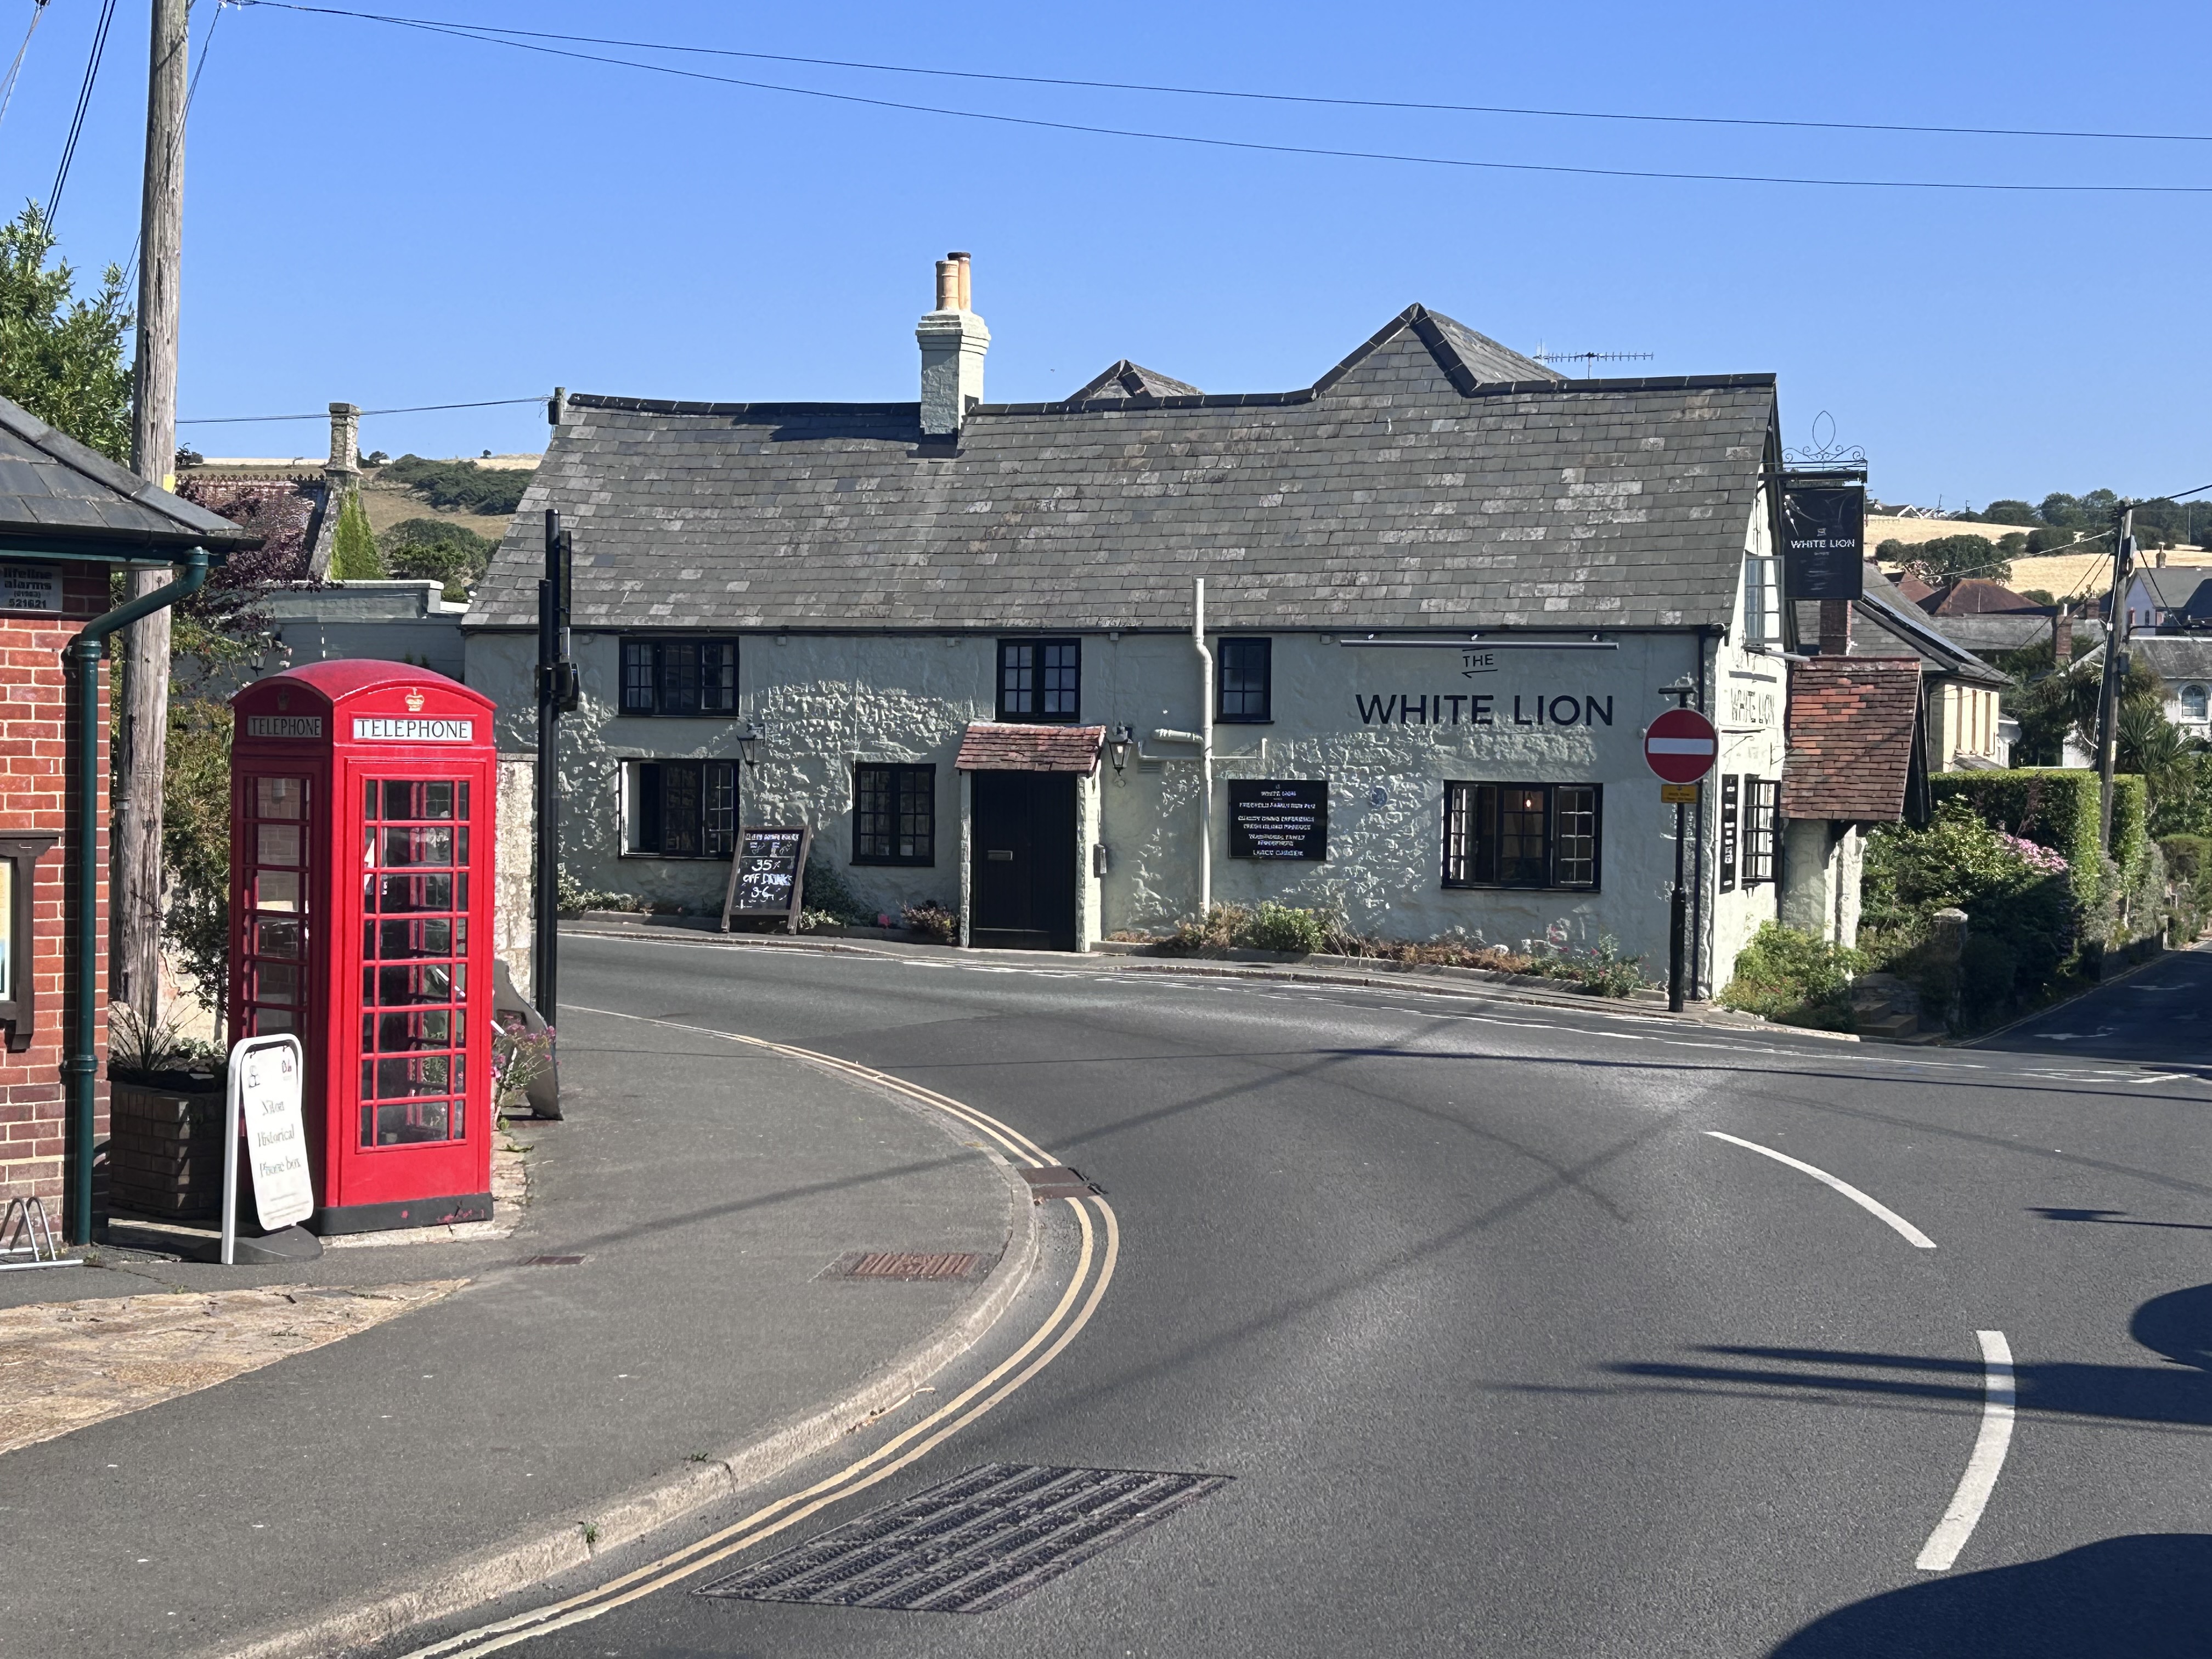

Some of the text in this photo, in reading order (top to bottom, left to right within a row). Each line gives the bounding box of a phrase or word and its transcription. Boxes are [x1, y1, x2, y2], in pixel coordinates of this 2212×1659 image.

[1791, 539, 1855, 549] WHITE LION
[4, 567, 52, 579] lifeline
[4, 579, 52, 590] alarms
[1463, 654, 1494, 667] THE
[1355, 694, 1613, 726] WHITE LION
[251, 718, 321, 737] TELEPHONE
[358, 719, 468, 738] TELEPHONE
[751, 859, 781, 872] 35%
[743, 873, 761, 884] OFF
[258, 1124, 295, 1148] Historical
